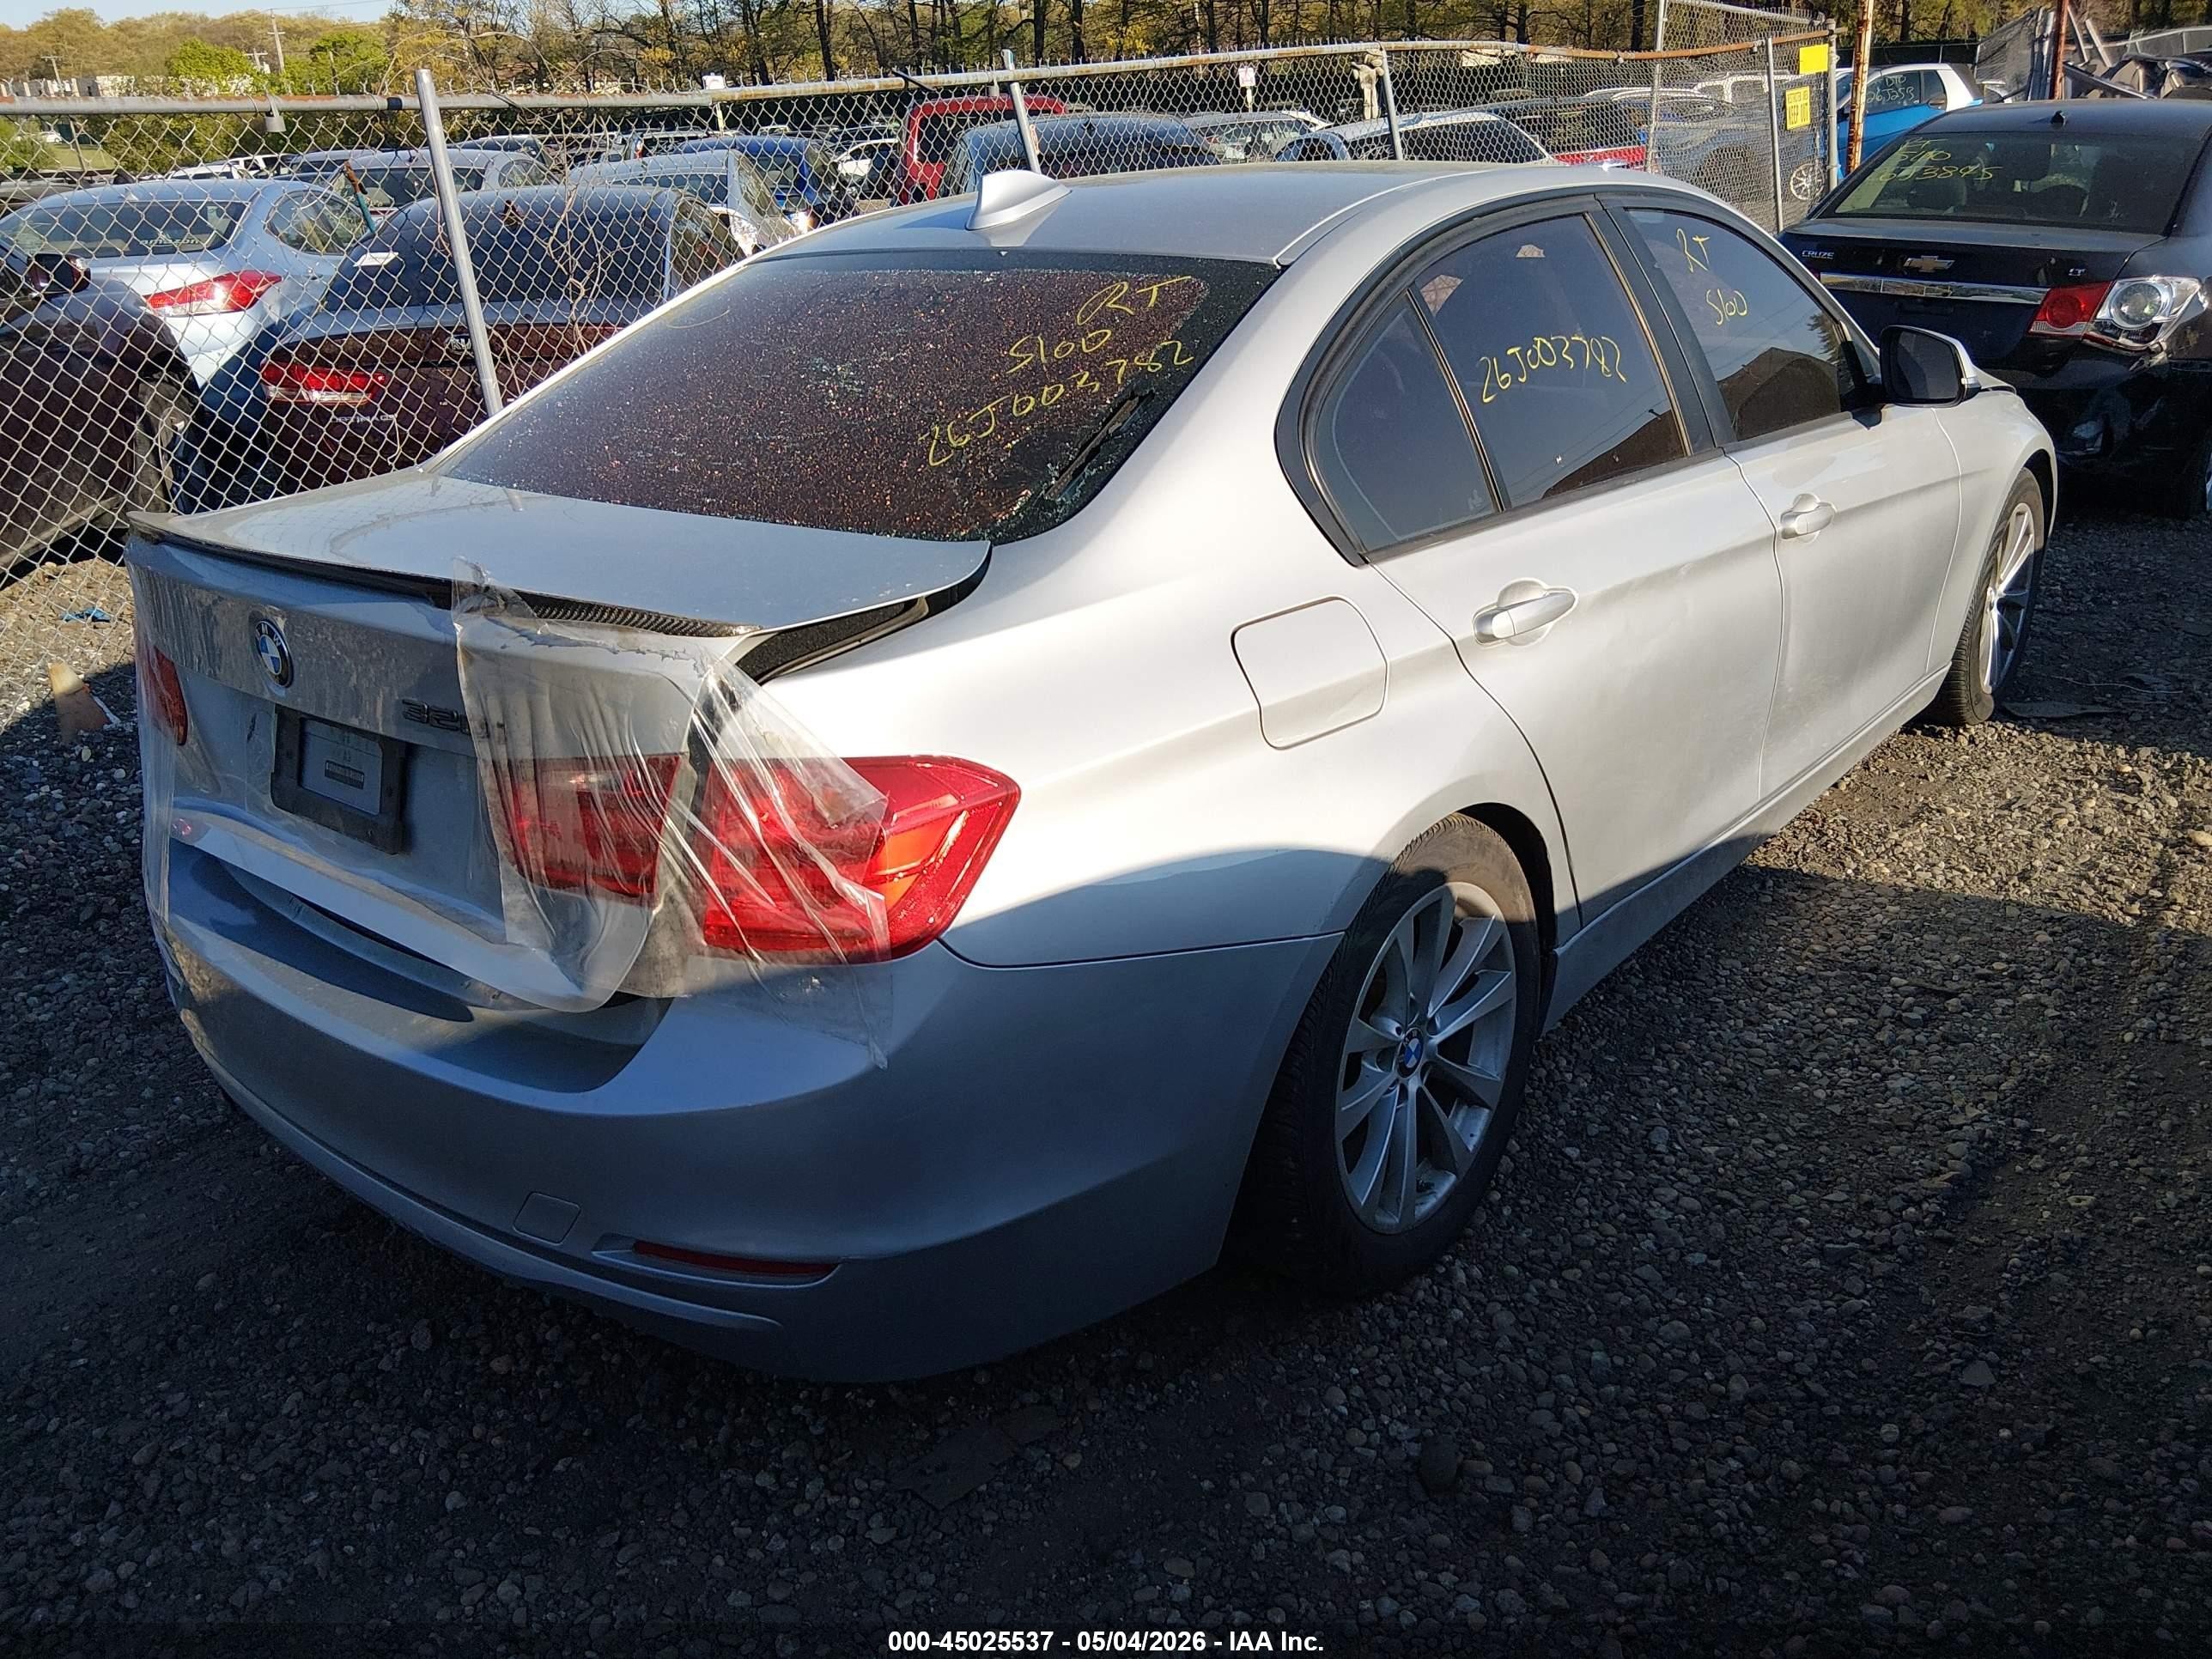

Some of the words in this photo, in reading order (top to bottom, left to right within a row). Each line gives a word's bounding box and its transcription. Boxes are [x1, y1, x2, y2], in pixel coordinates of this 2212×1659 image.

[1676, 228, 1711, 273] RT
[1802, 250, 1835, 260] CRUZE
[1076, 275, 1193, 326] RT
